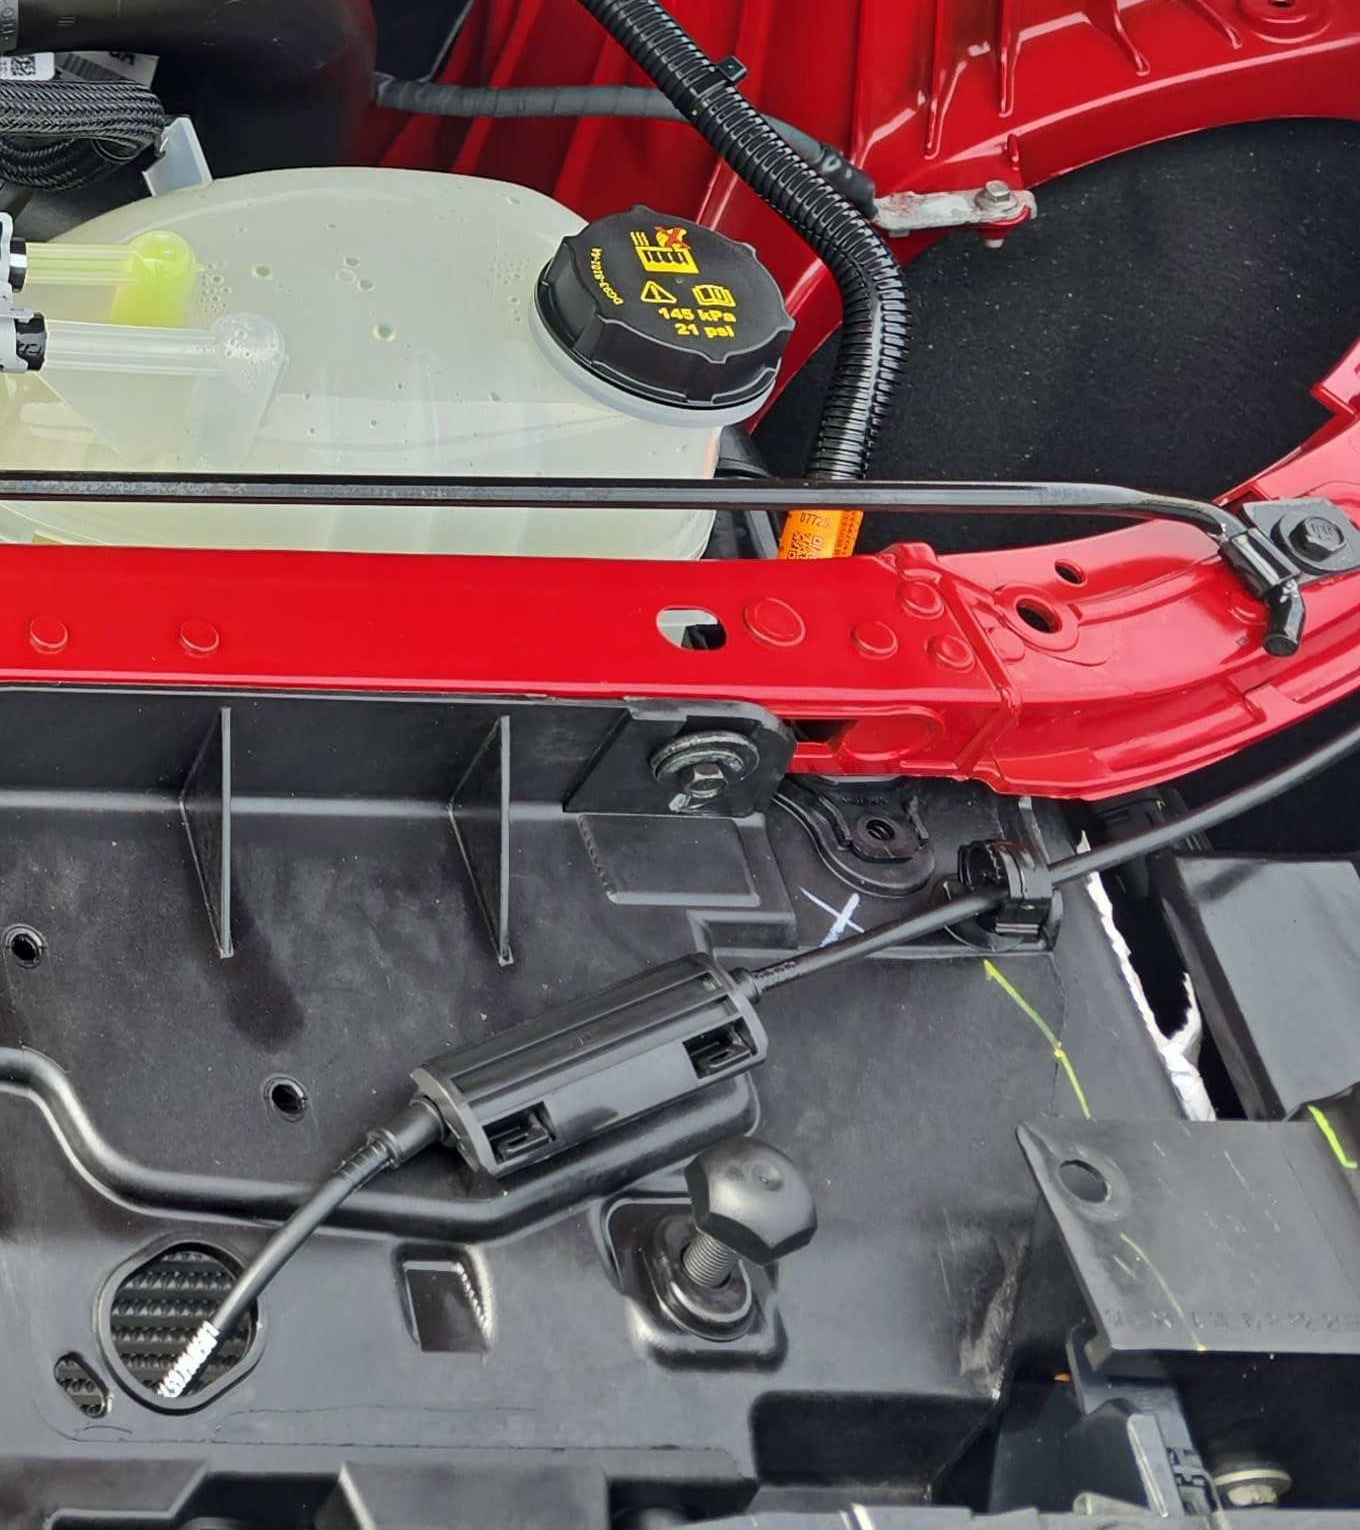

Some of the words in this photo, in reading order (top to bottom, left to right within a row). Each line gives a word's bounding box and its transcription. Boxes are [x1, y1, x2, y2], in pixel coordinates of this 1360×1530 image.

[658, 306, 696, 321] 145
[697, 308, 737, 323] kPa
[674, 323, 700, 337] 21
[703, 325, 736, 340] psi
